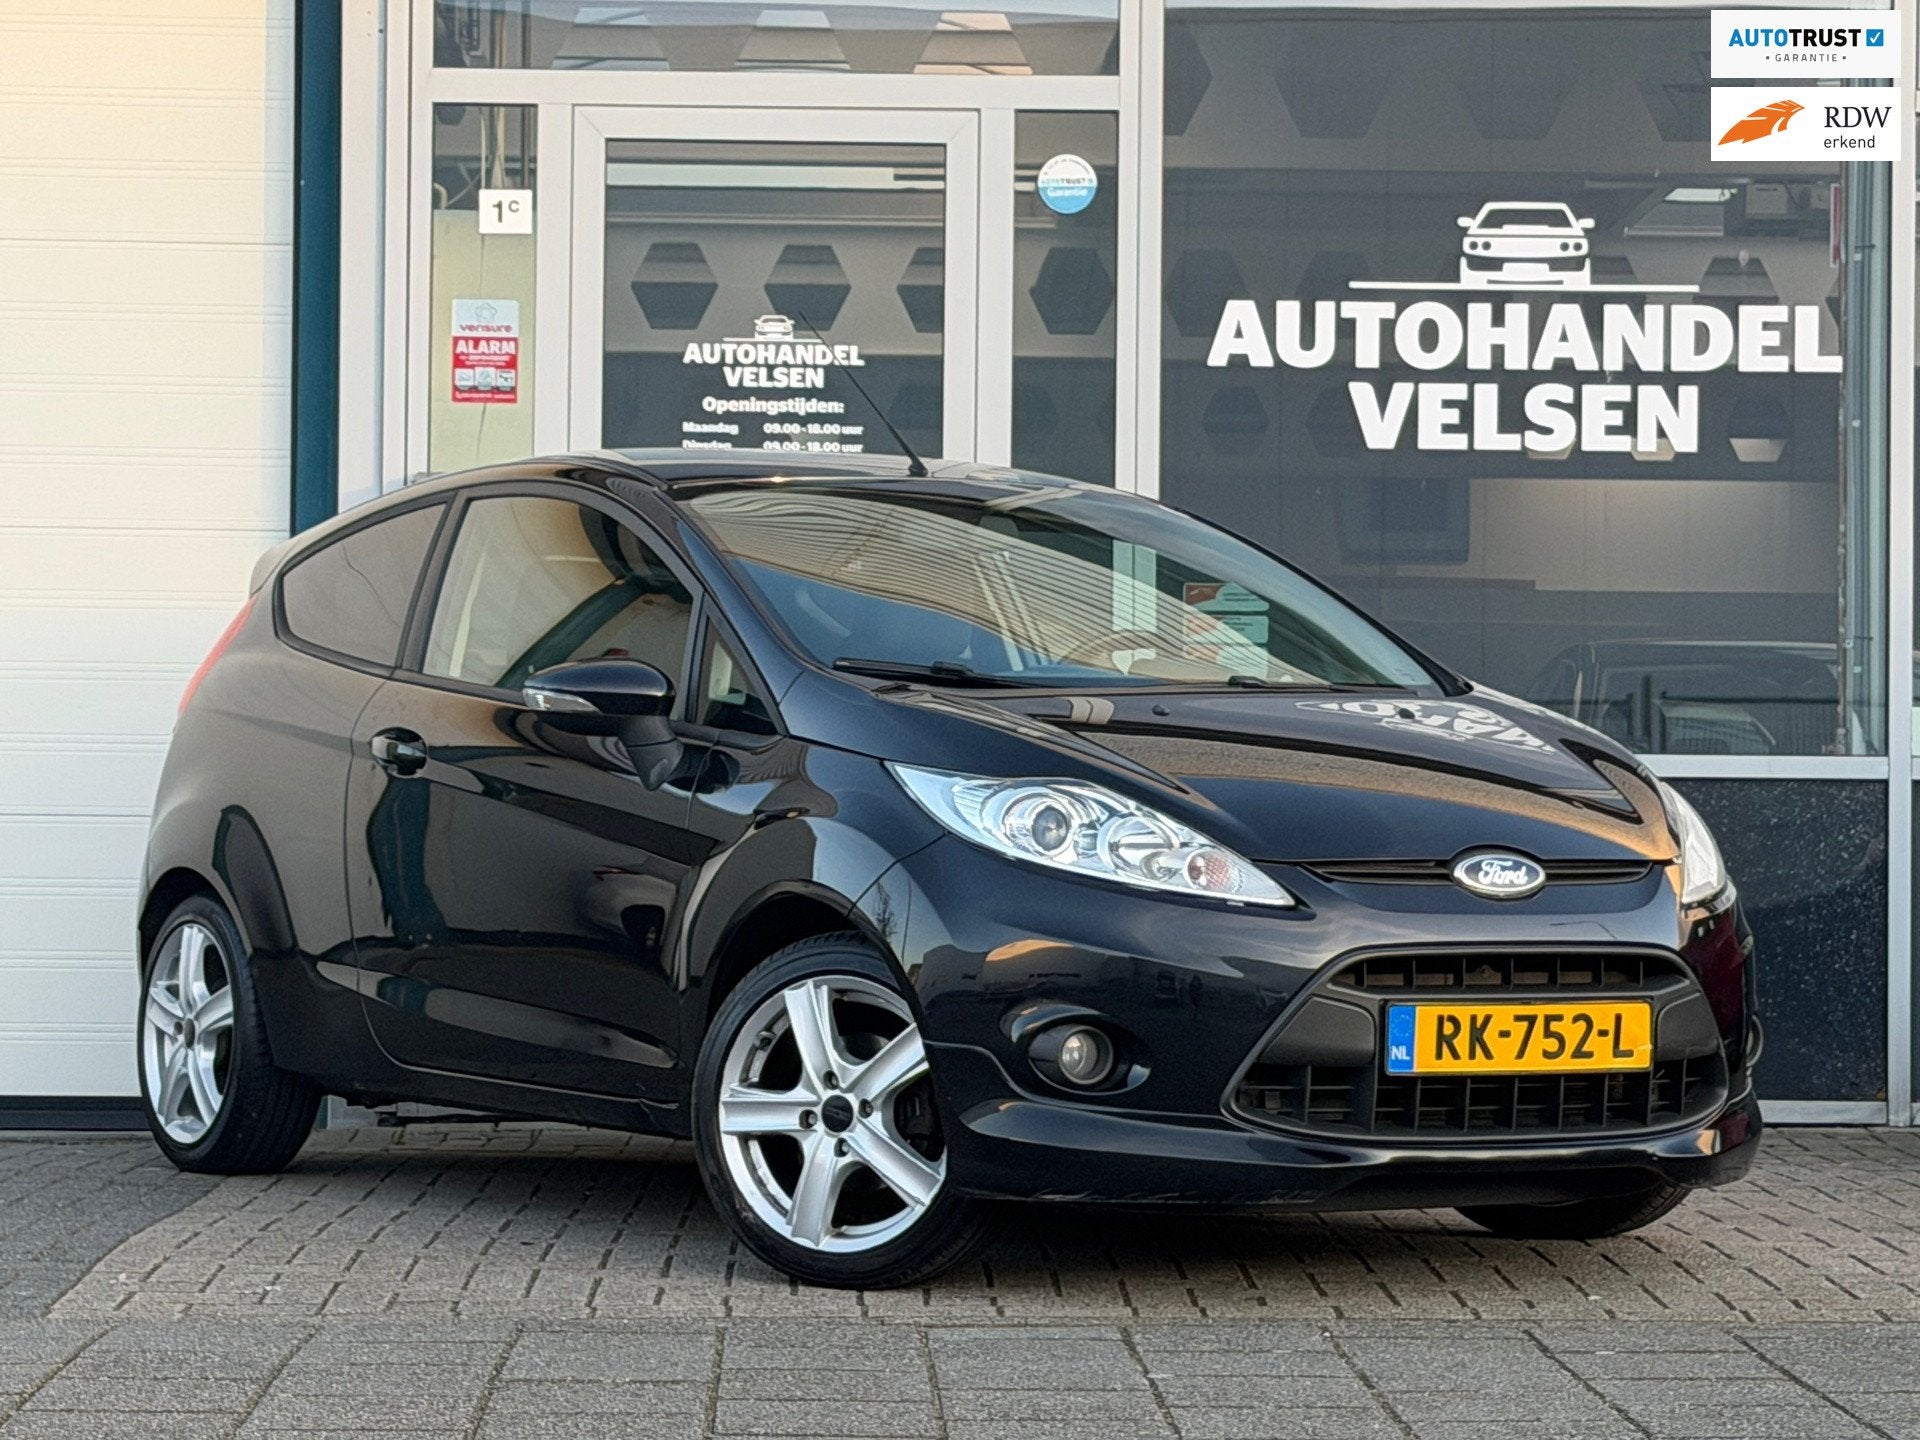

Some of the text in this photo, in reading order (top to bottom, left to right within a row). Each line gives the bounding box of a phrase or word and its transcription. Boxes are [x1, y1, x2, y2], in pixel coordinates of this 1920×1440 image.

[455, 339, 516, 355] ALARM
[1206, 299, 1843, 373] AUTOHANDEL
[683, 342, 865, 366] AUTOHANDEL
[723, 366, 825, 388] VELSEN
[702, 396, 845, 415] Openingstijden:
[1348, 381, 1698, 453] VELSEN
[1477, 859, 1529, 886] Ford
[1391, 1012, 1635, 1061] NL RK-752-L
